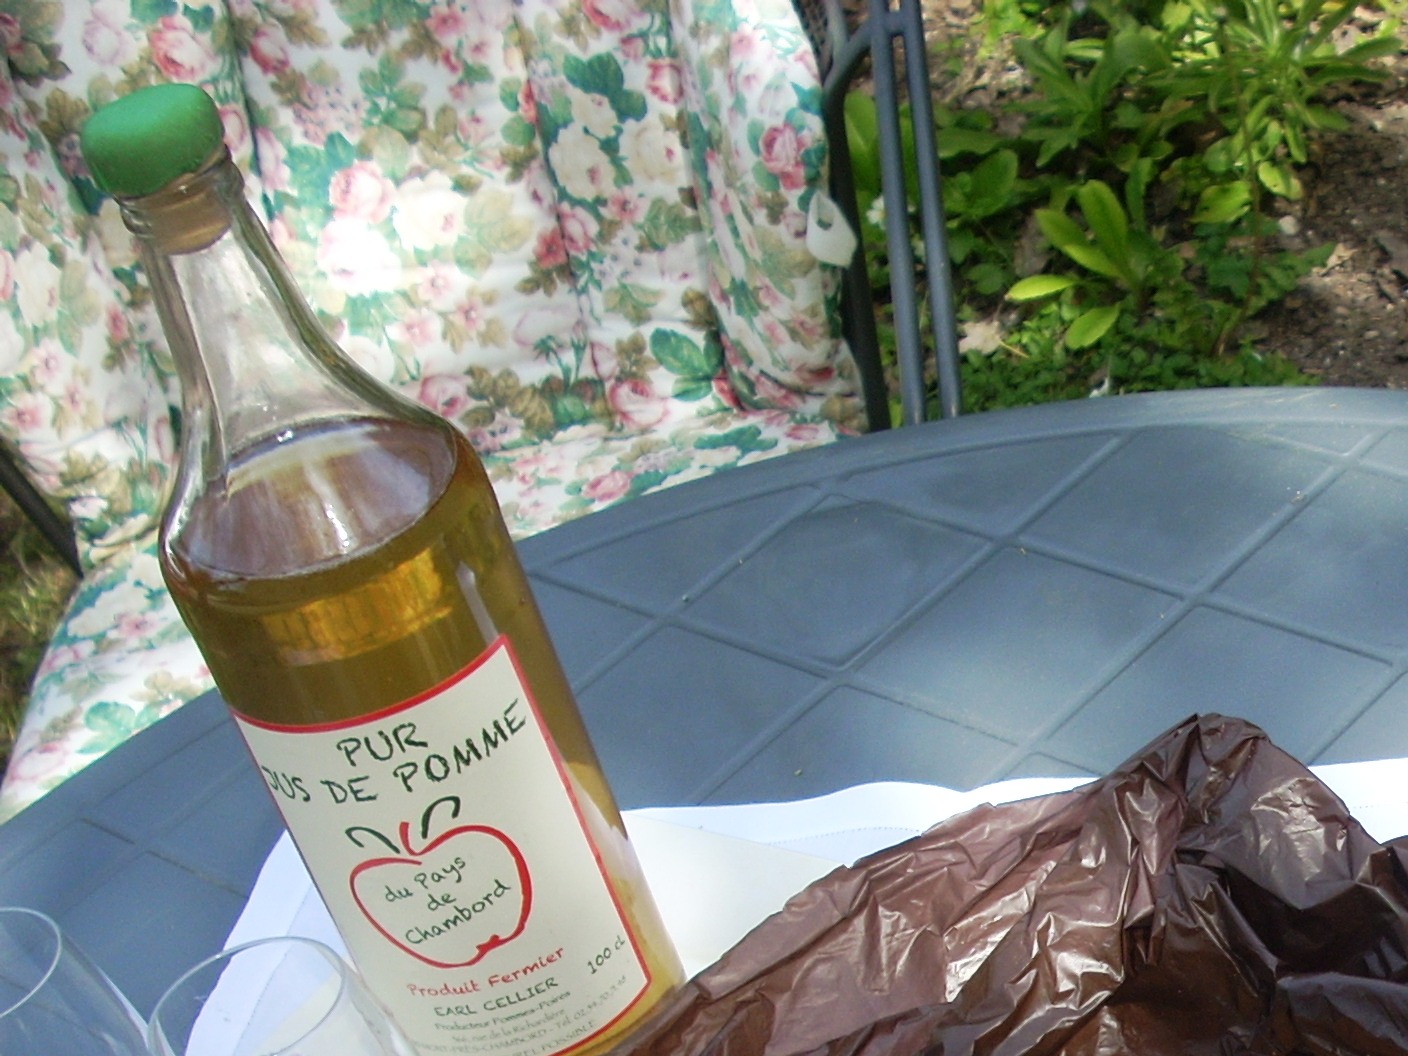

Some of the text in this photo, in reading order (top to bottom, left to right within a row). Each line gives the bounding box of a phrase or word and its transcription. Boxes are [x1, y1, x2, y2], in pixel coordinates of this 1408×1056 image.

[261, 698, 527, 803] JUS DE POMME
[337, 722, 428, 767] PUR
[385, 885, 414, 902] du
[405, 879, 512, 944] Chambord
[427, 894, 457, 911] de
[406, 947, 565, 998] Produit Fermier
[587, 947, 615, 975] 100
[434, 1000, 477, 1017] EARL
[483, 976, 559, 1012] CELLIER
